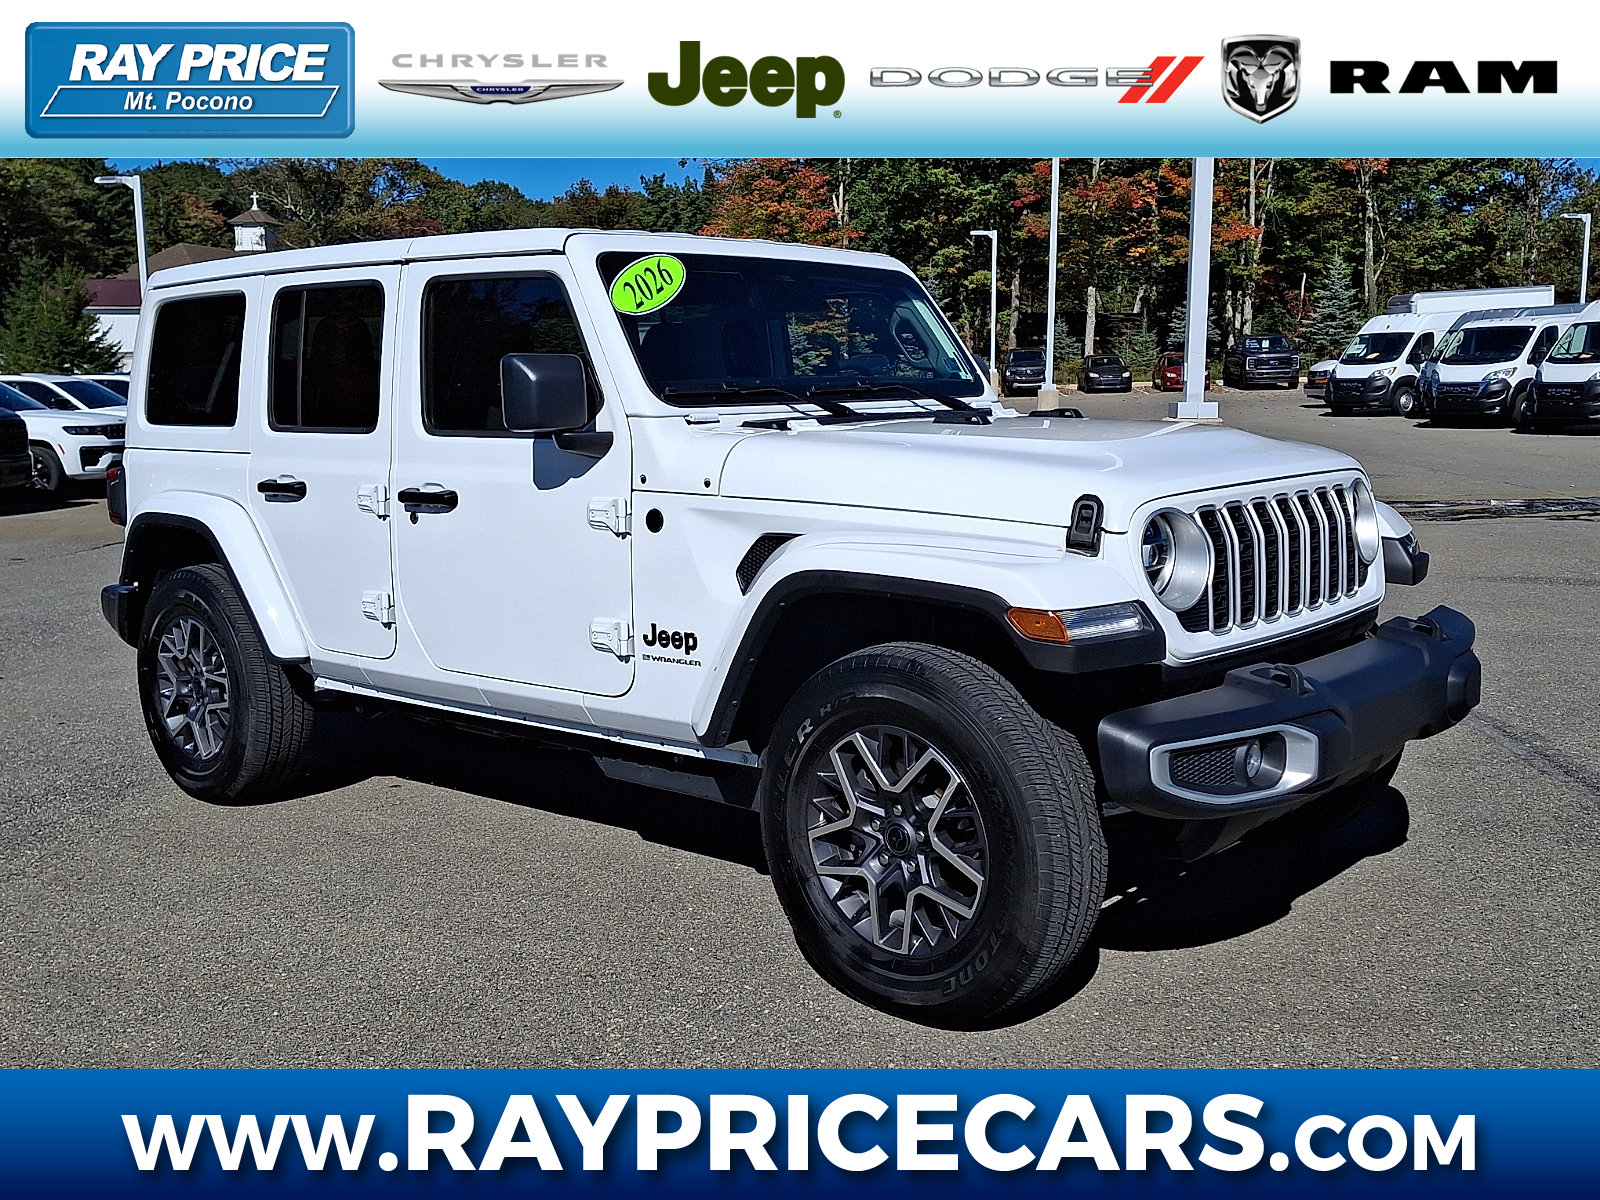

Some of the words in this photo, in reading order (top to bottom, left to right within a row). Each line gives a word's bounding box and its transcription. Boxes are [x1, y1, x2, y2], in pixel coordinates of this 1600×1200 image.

[623, 258, 674, 310] 2026
[642, 622, 698, 655] Jeep
[651, 654, 702, 667] WRANGLER
